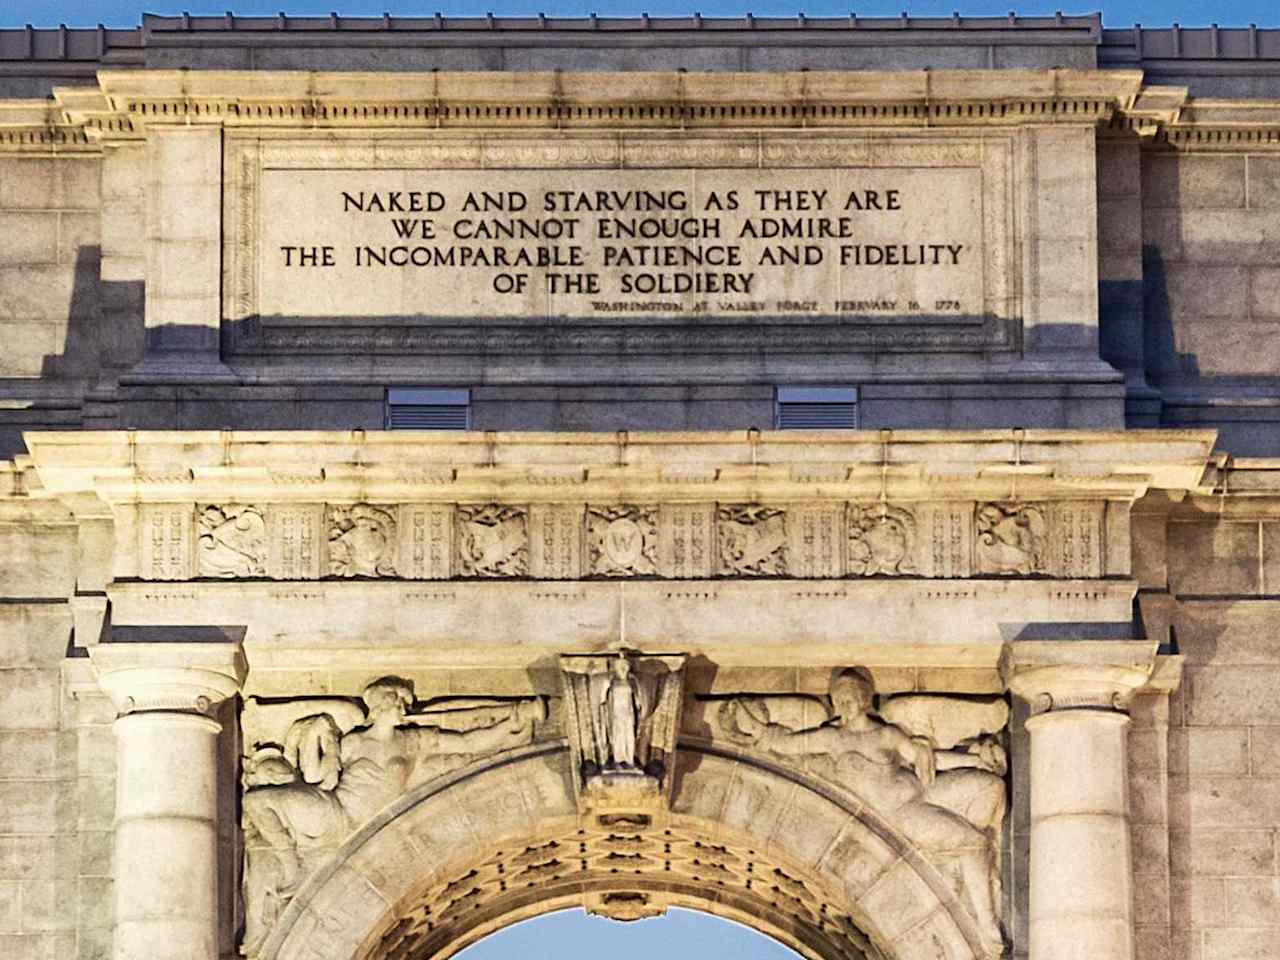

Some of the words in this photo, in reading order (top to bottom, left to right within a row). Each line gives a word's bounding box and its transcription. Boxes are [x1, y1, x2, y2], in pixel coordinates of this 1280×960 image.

[341, 191, 446, 213] NAKED
[462, 191, 528, 213] AND
[543, 190, 687, 212] STARVING
[704, 190, 740, 211] AS
[755, 189, 828, 211] THEY
[844, 190, 902, 211] ARE
[391, 219, 436, 239] WE
[452, 218, 580, 239] CANNOT
[598, 218, 721, 239] ENOUGH
[738, 217, 854, 239] ADMIRE
[280, 246, 336, 267] THE
[355, 246, 586, 267] INCOMPARABLE
[603, 246, 741, 267] PATIENCE
[758, 246, 824, 266] AND
[839, 245, 964, 267] FIDELITY
[493, 273, 528, 294] OF
[545, 273, 600, 294] THE
[621, 273, 755, 294] SOLDIERY
[591, 301, 683, 312] WASHINGTON
[693, 301, 708, 312] AT
[717, 301, 766, 312] VALLEY
[776, 300, 818, 311] FORGE
